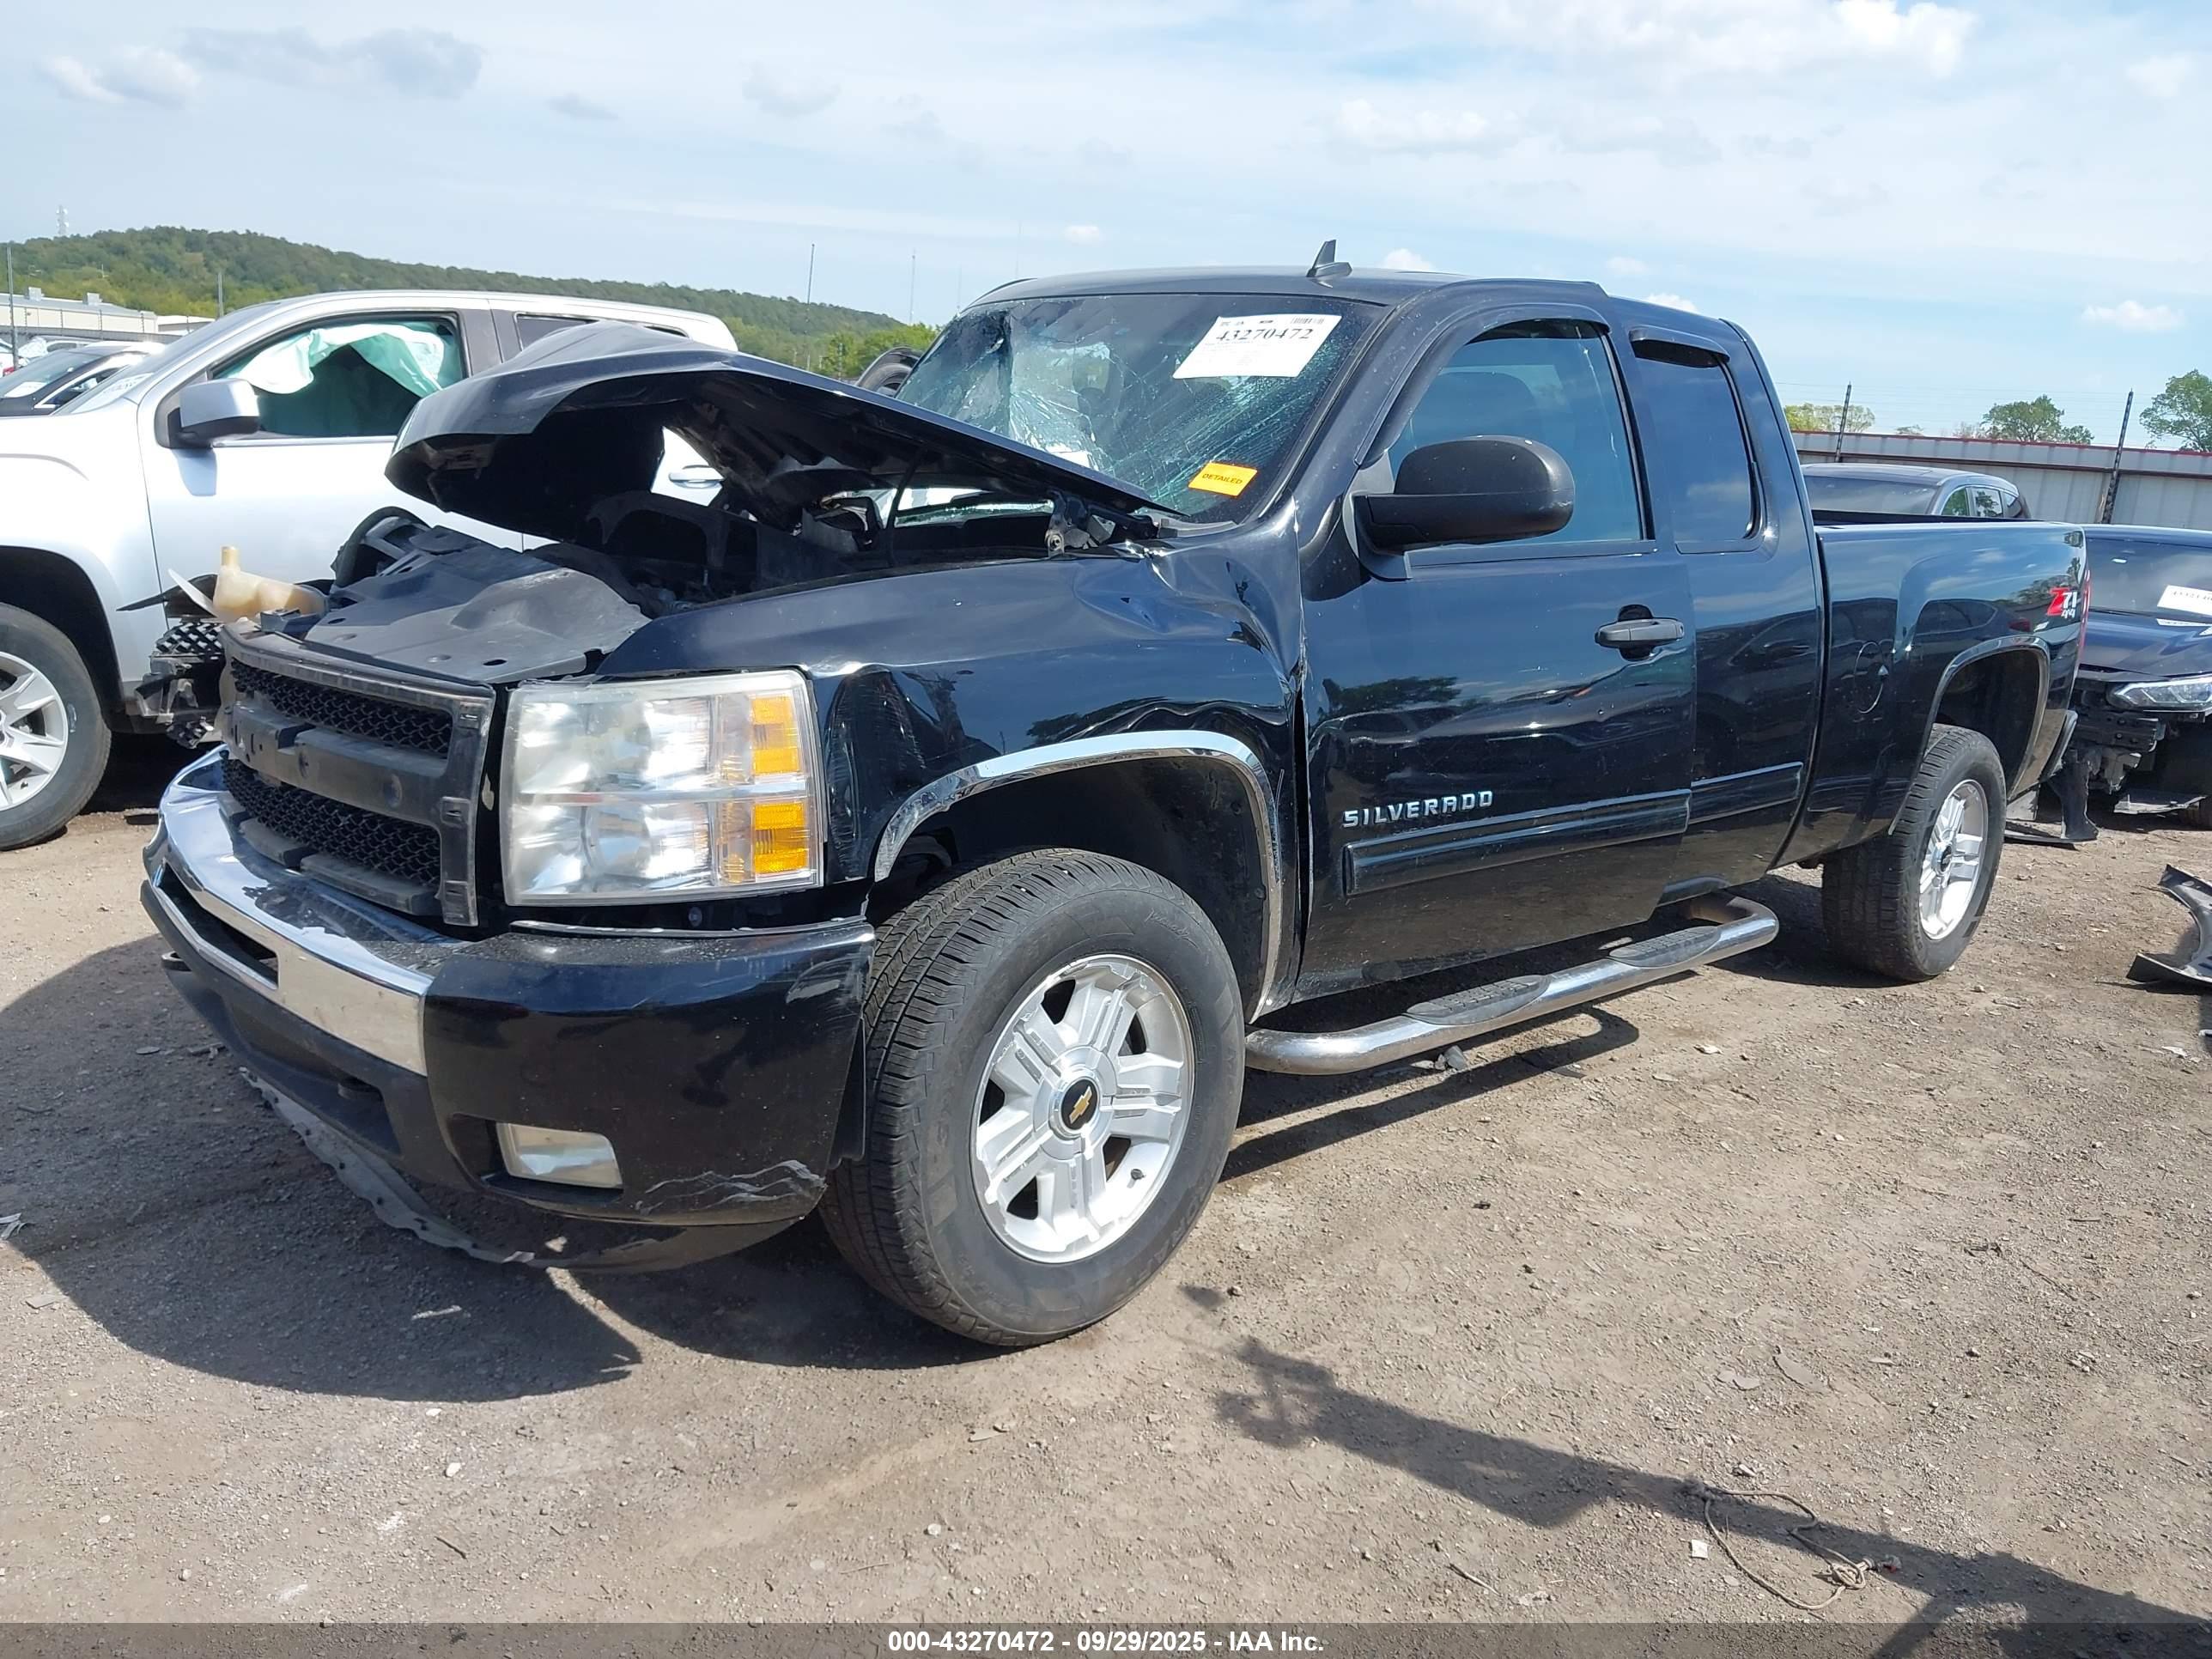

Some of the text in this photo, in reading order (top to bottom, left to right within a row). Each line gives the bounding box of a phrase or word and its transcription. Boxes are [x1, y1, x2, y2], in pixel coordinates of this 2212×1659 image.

[1216, 328, 1314, 342] 43270472
[1202, 473, 1243, 484] DETAILED
[2047, 586, 2078, 616] Z71
[1342, 790, 1494, 829] SILVERADO
